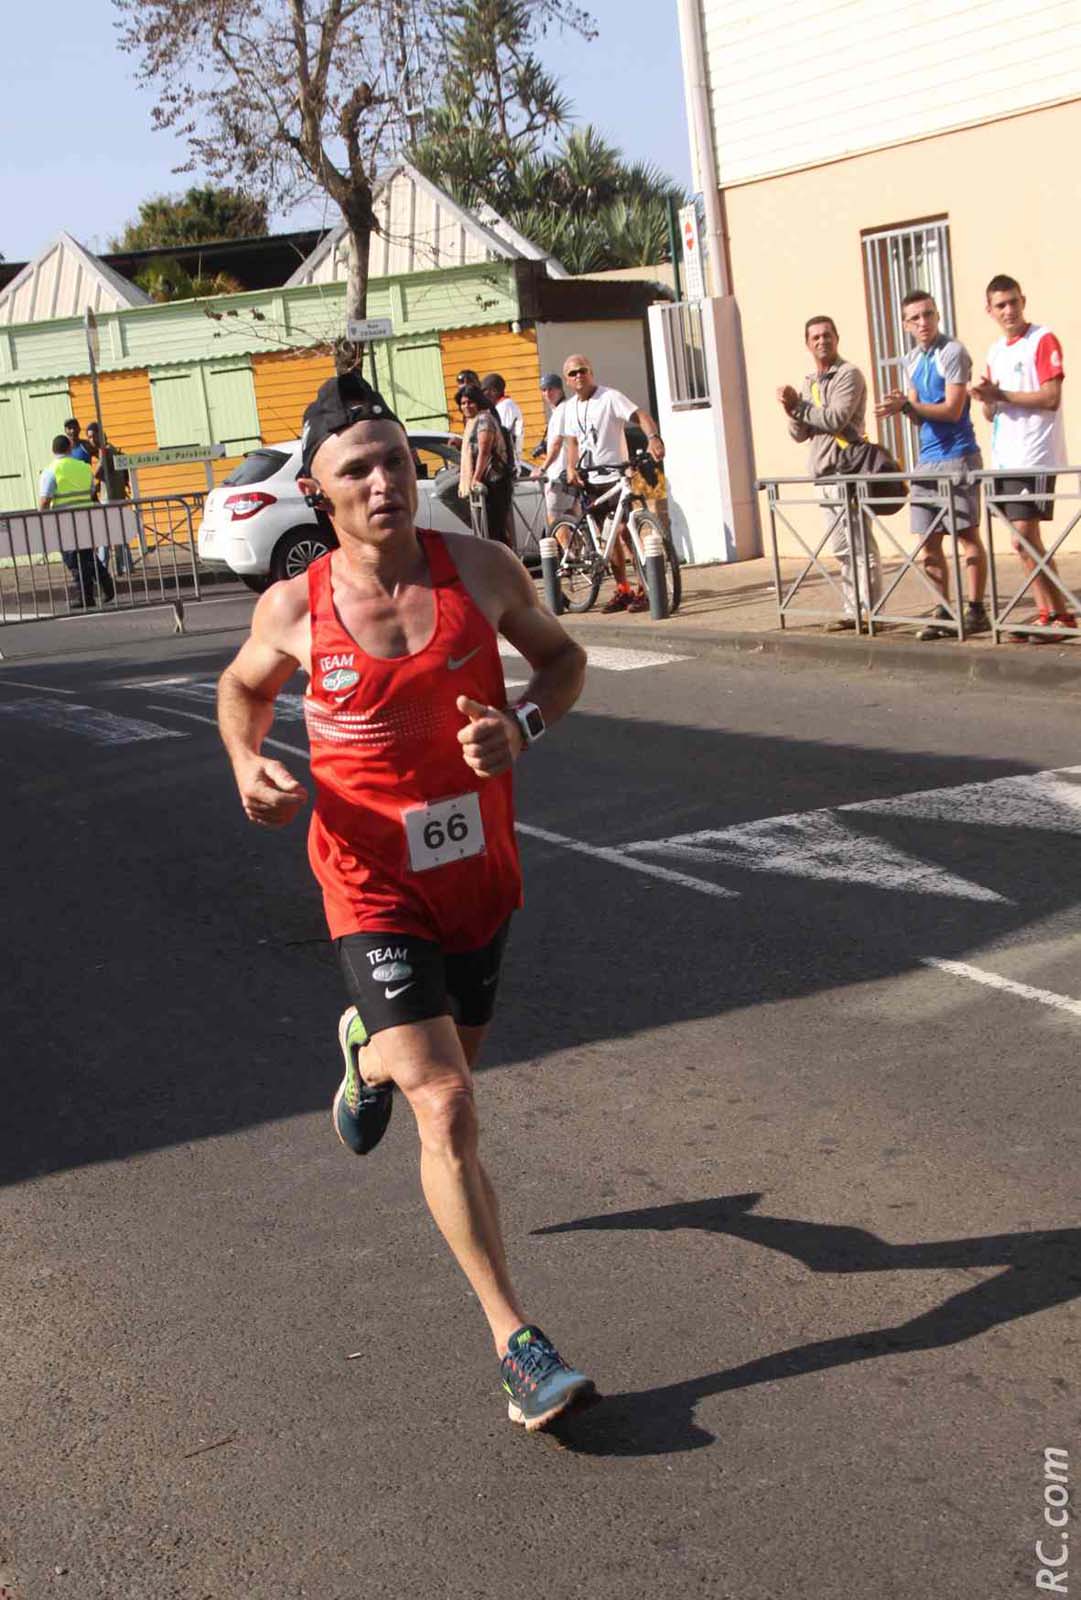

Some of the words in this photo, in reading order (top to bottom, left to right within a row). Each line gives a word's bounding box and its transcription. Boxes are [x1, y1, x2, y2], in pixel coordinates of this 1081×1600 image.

[320, 653, 355, 672] TEAM
[423, 813, 468, 849] 66
[366, 947, 408, 965] TEAM
